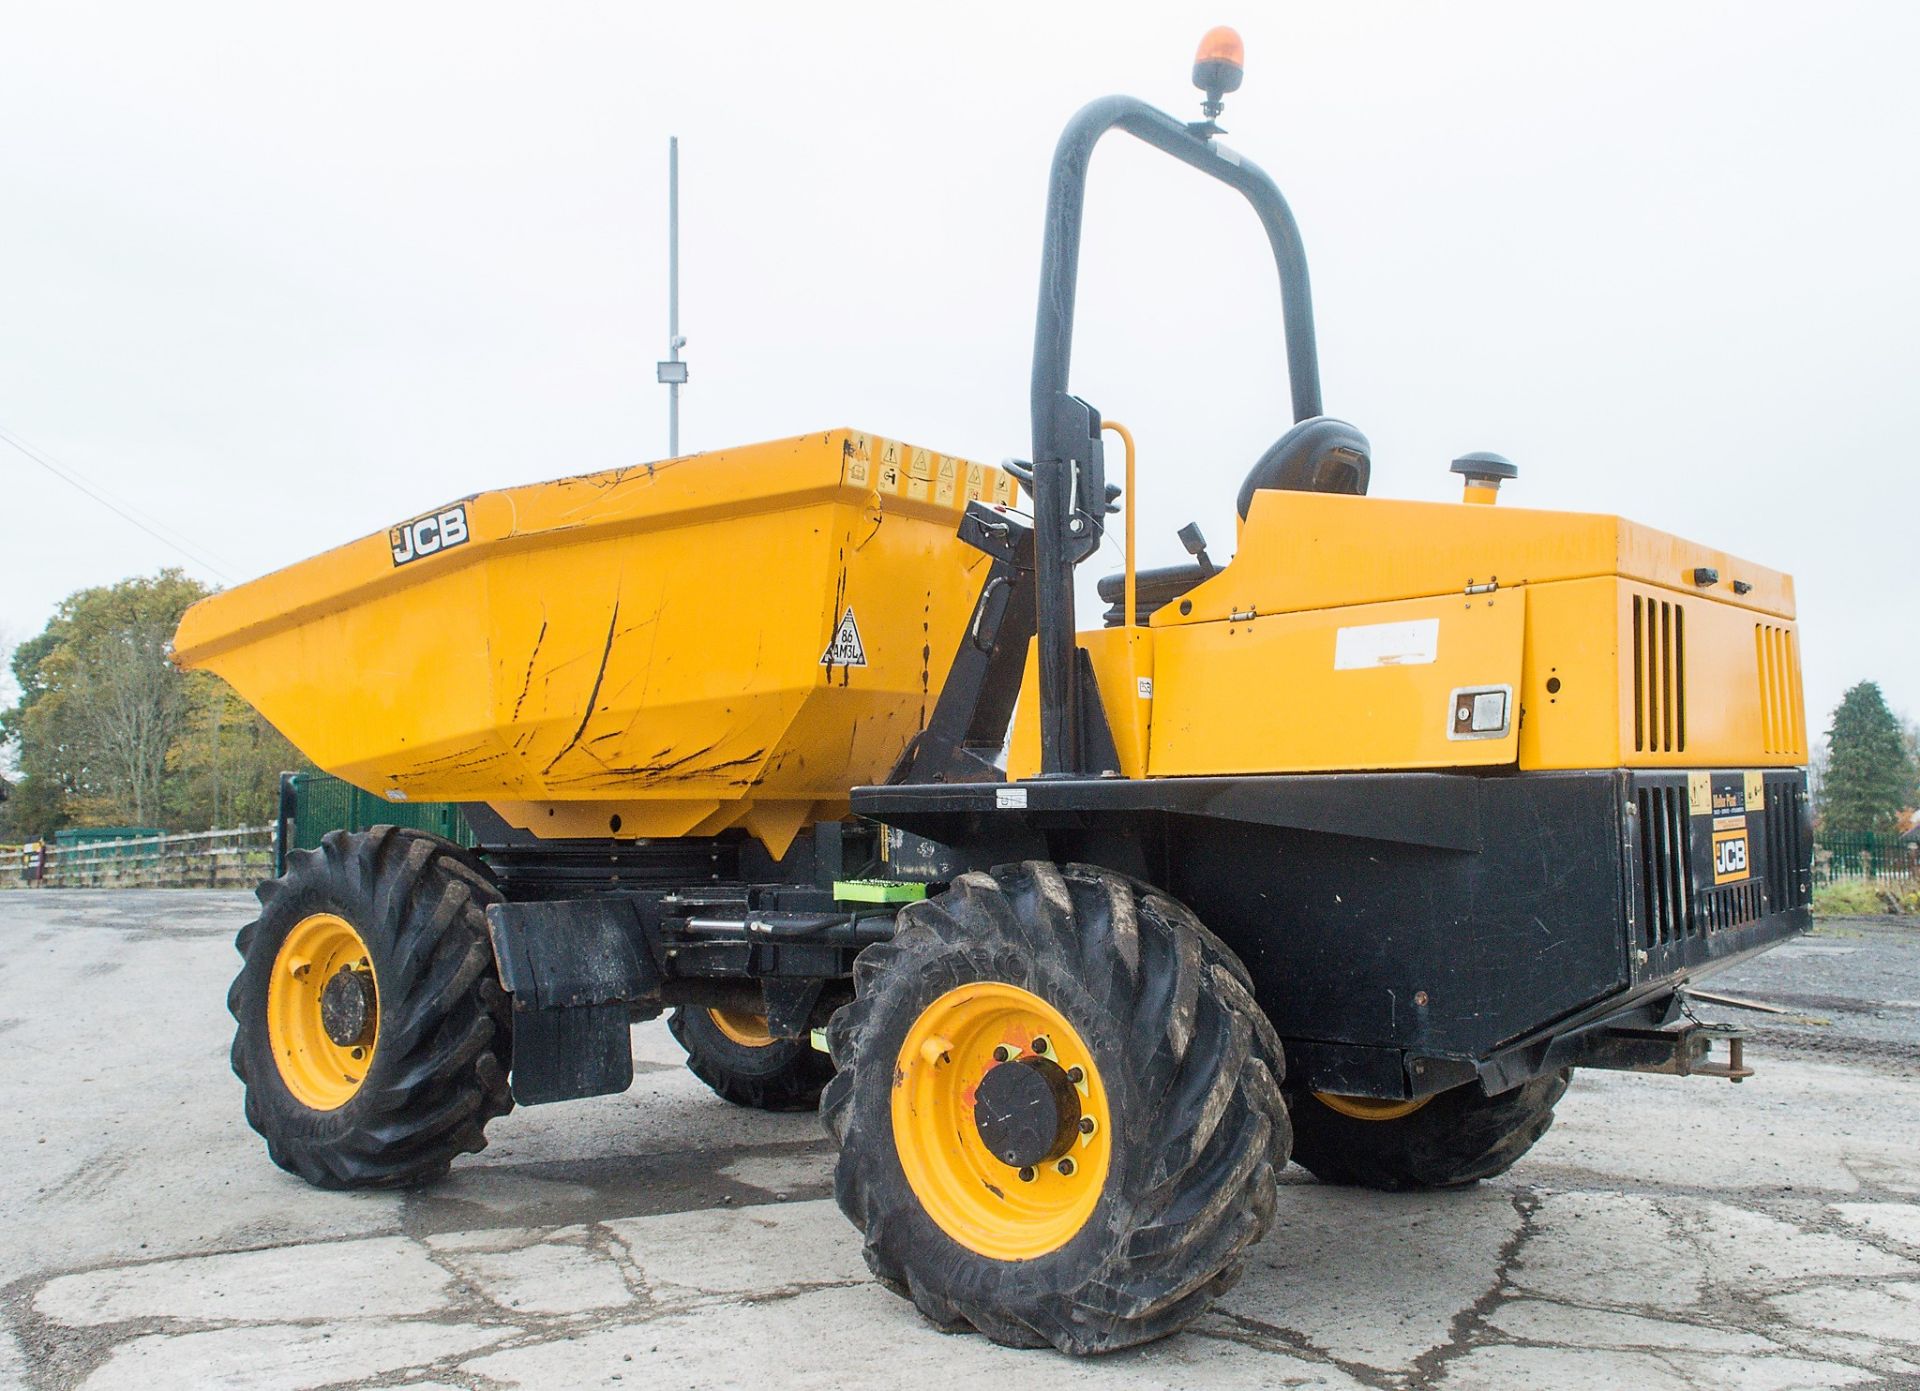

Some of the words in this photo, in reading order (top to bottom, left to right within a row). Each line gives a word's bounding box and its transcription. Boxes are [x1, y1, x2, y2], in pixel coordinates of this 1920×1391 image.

[391, 508, 468, 563] JCB
[841, 629, 853, 643] 86
[1716, 839, 1746, 873] JCB
